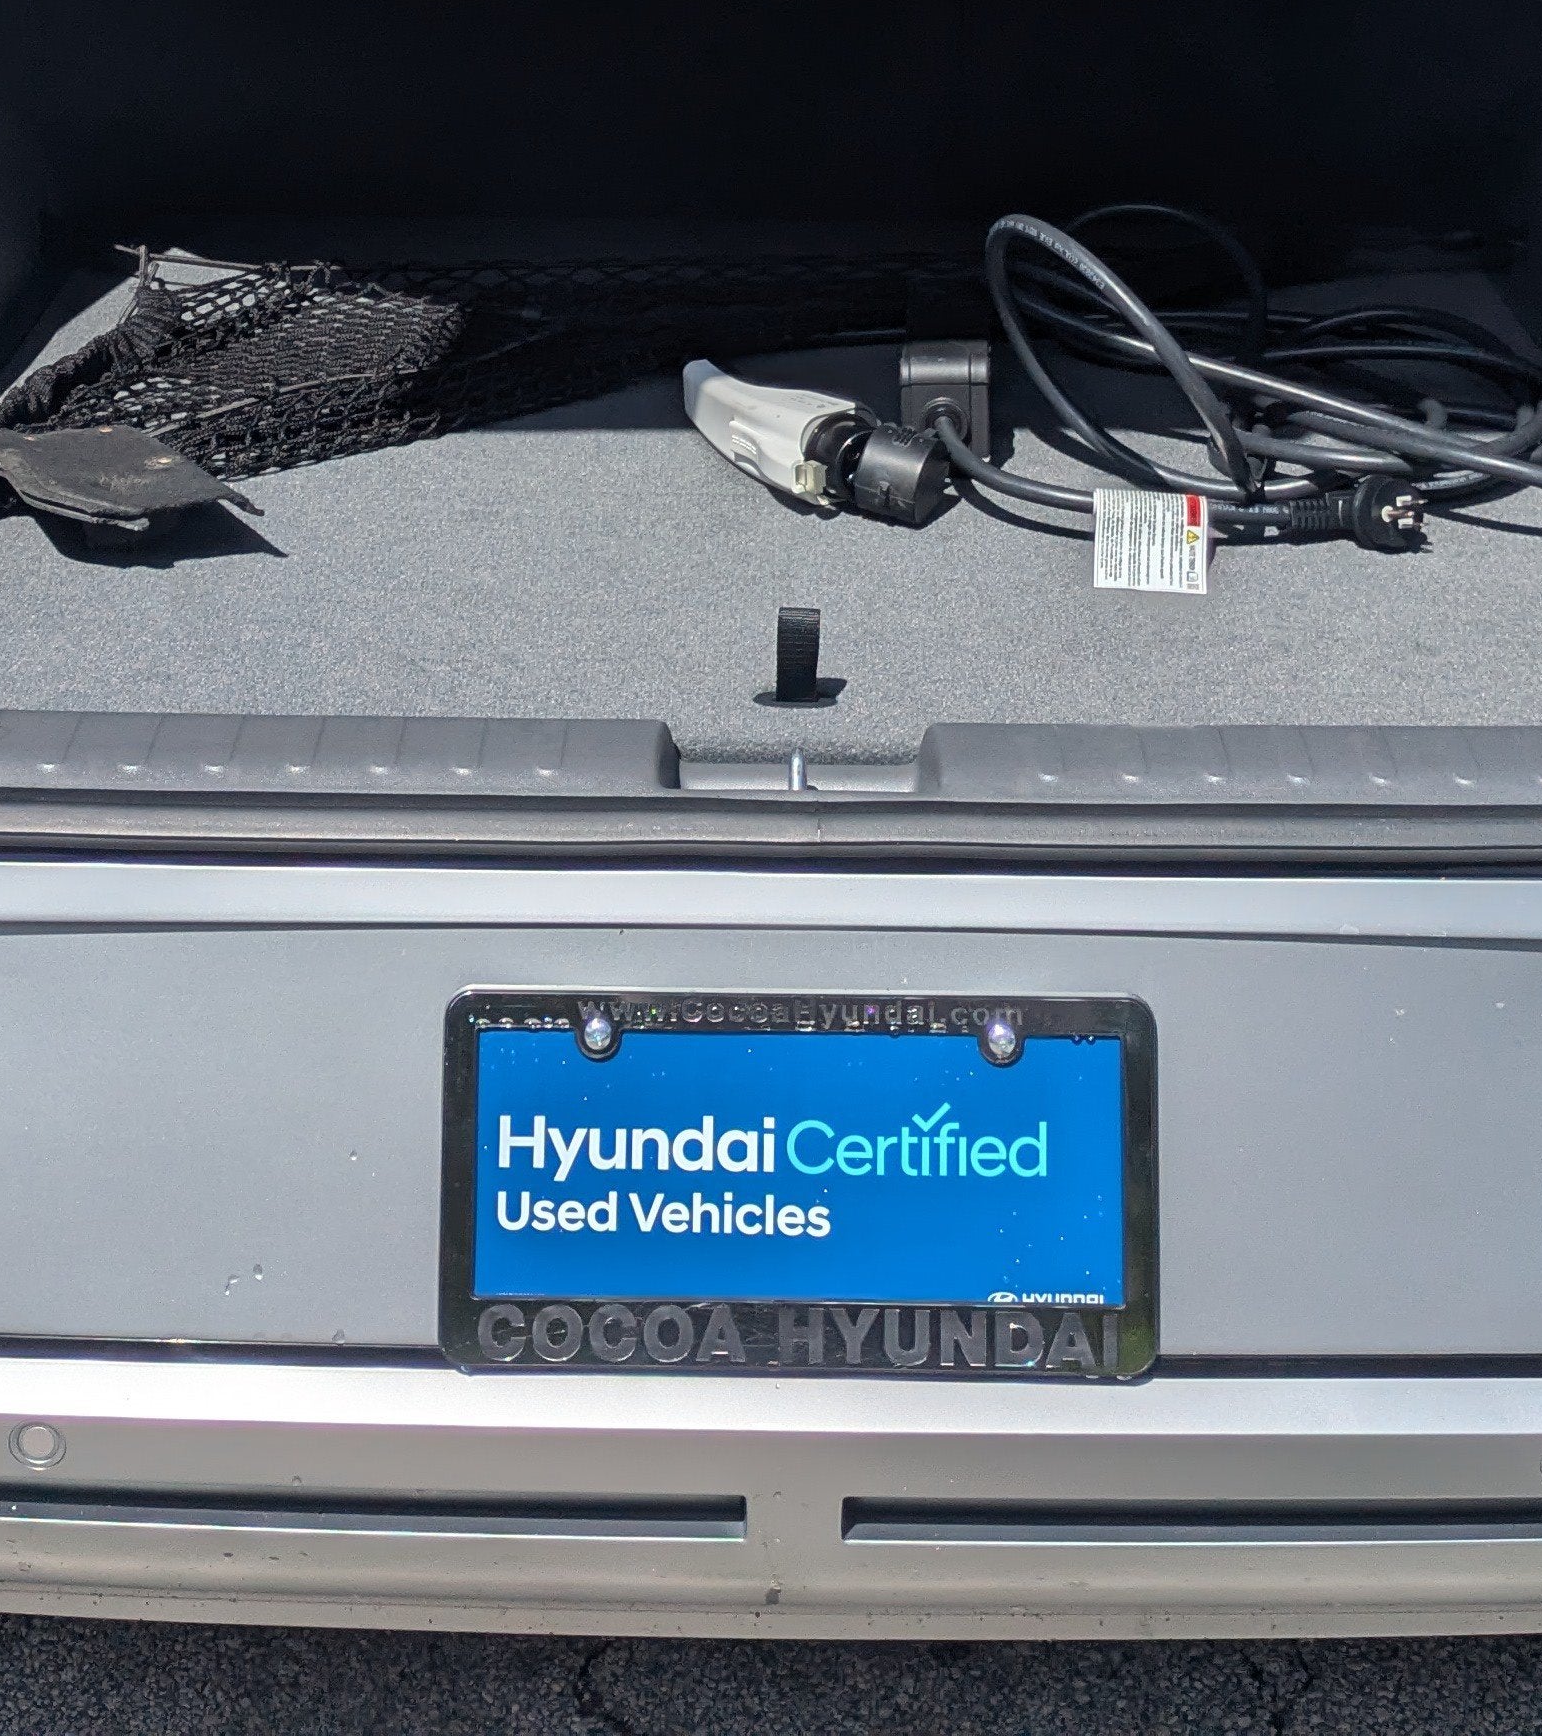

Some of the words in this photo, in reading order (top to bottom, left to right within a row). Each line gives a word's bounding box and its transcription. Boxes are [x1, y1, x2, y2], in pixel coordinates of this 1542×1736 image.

[497, 1115, 776, 1182] Hyundai
[786, 1102, 1049, 1178] Certified
[496, 1191, 619, 1232] Used
[629, 1192, 832, 1238] Vehicles
[477, 1303, 747, 1363] COCOA
[777, 1307, 1120, 1371] HYUNDAI
